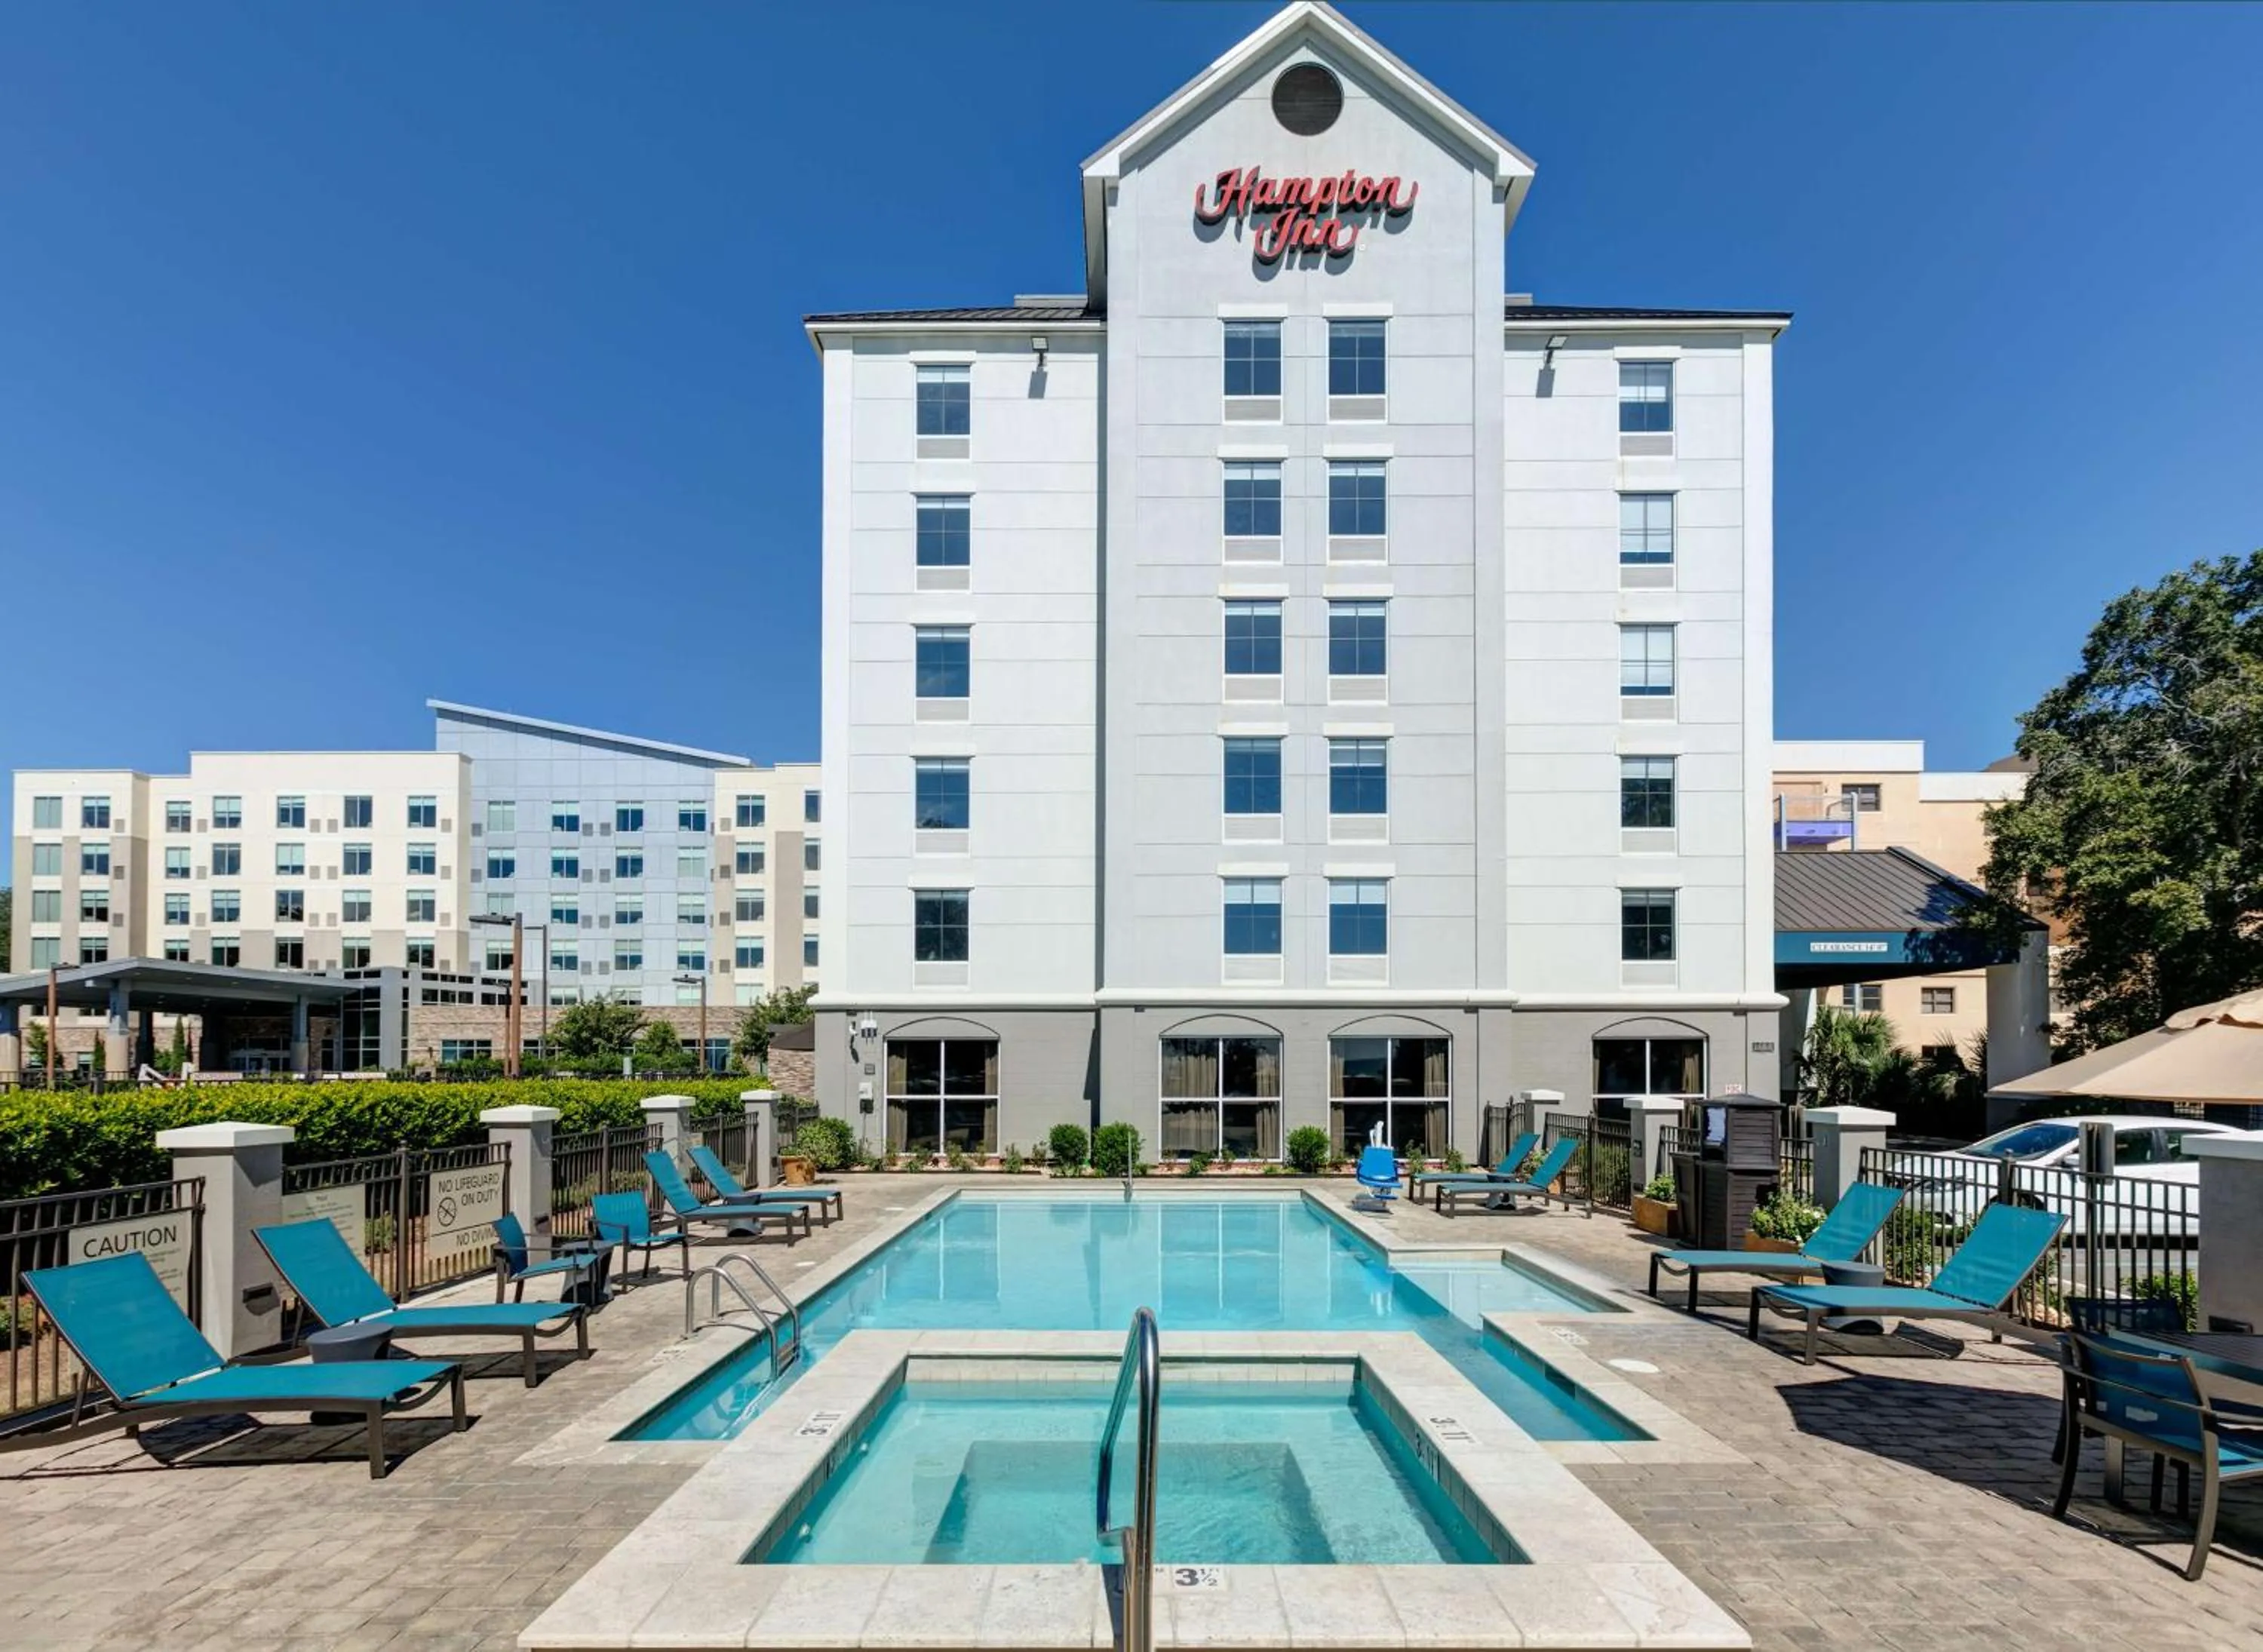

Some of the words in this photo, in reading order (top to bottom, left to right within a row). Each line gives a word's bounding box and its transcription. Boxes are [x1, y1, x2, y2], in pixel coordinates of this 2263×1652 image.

[1196, 164, 1418, 219] Hampton
[1254, 207, 1358, 257] Inn
[438, 1179, 453, 1193] NO
[455, 1173, 499, 1191] LIFEGUARD
[461, 1193, 474, 1205] ON
[476, 1187, 499, 1203] DUTY
[83, 1225, 177, 1257] CAUTION
[456, 1232, 470, 1246] NO
[471, 1227, 495, 1243] DIVIN
